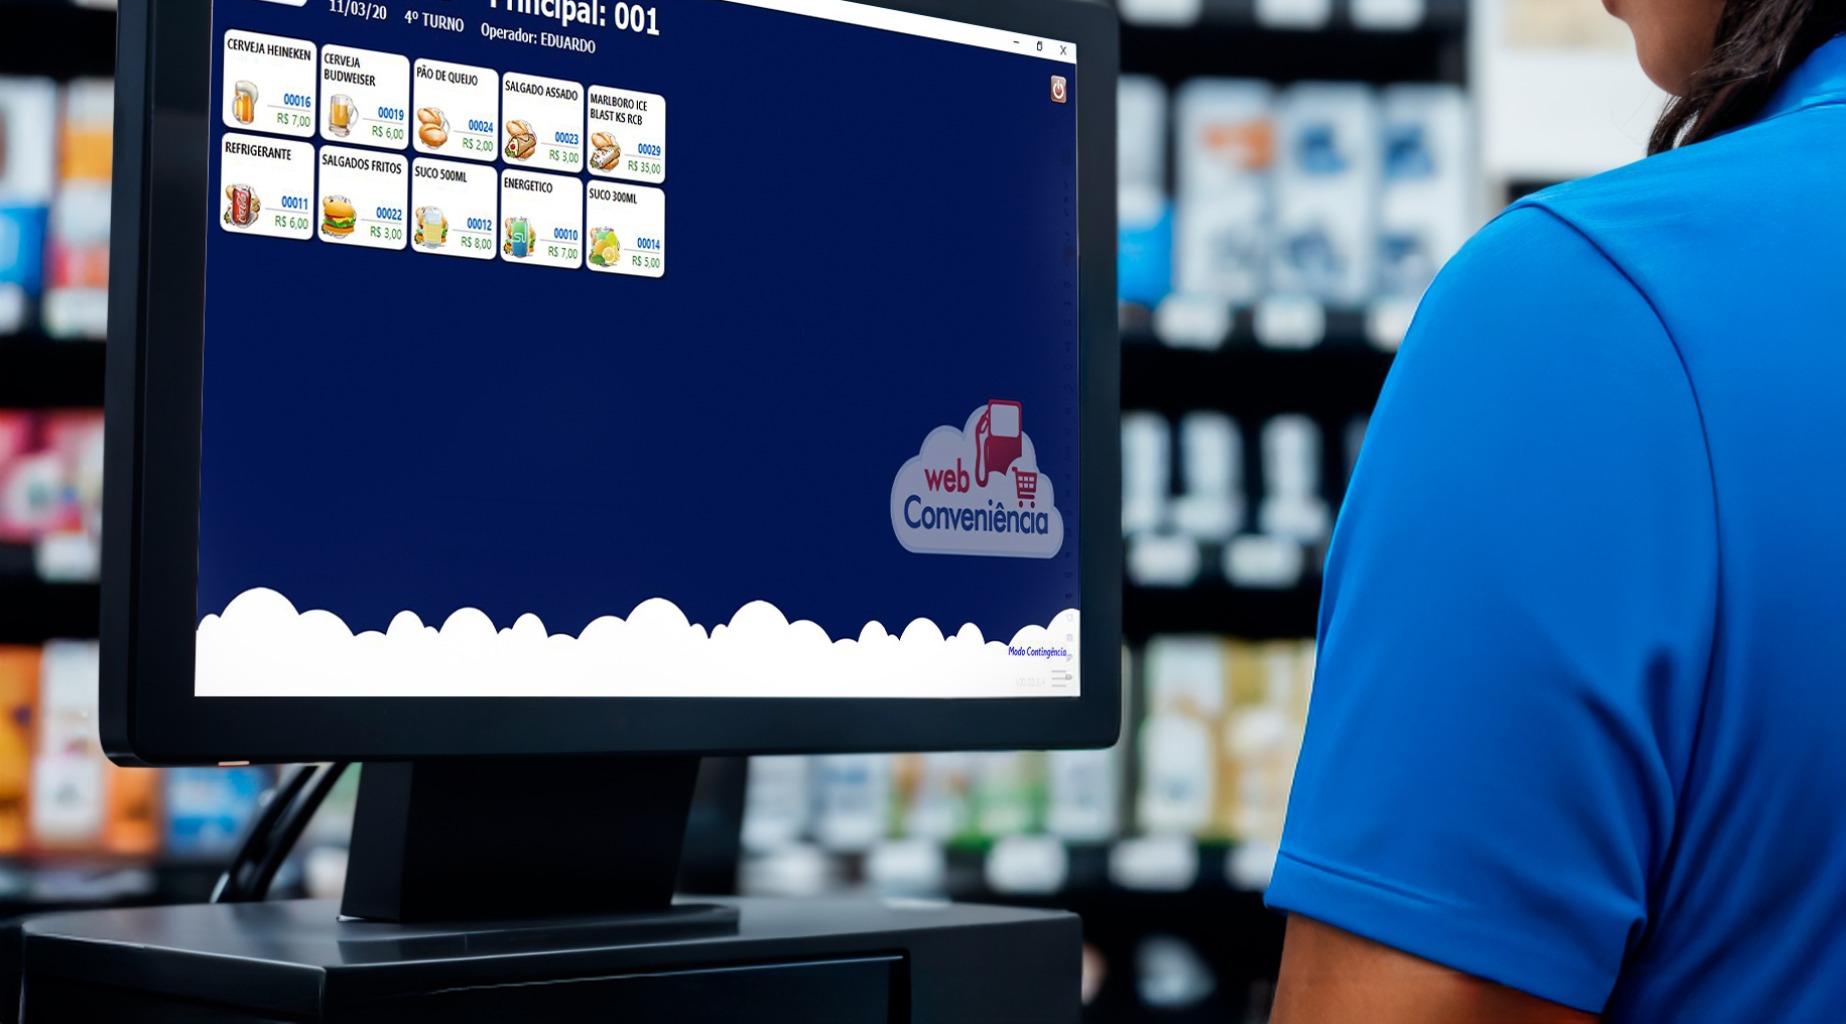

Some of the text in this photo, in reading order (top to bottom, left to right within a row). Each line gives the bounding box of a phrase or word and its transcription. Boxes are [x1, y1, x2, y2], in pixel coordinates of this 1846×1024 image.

[615, 1, 660, 37] 001
[422, 12, 464, 33] TURNO
[481, 22, 537, 45] Operador:
[541, 32, 596, 54] EDUARDO
[227, 38, 311, 61] CERVEJA HEINEKEN
[324, 53, 361, 69] CERVEJA
[324, 68, 376, 87] BUDWEISER
[417, 64, 478, 87] PÃO DE QUEIJO
[505, 80, 578, 101] SALGADO ASSADO
[284, 93, 311, 108] 00016
[590, 93, 648, 112] MARLBORO ICE
[277, 112, 311, 128] R$ 7,00
[378, 107, 404, 121] 00019
[590, 108, 643, 126] BLAST KS RCB
[372, 125, 404, 140] R$ 6,00
[468, 119, 494, 133] 00024
[462, 137, 494, 152] R$ 2,00
[555, 131, 579, 145] 00023
[225, 141, 292, 161] REFRIGERANTE
[549, 149, 579, 164] R$ 3,00
[638, 143, 661, 157] 00029
[322, 154, 402, 175] SALGADOS FRITOS
[628, 160, 661, 175] R$ 35,00
[415, 165, 467, 183] SUCO 500ML
[504, 177, 553, 194] ENERGETICO
[282, 195, 309, 210] 00011
[589, 188, 637, 205] SUCO 300ML
[376, 206, 402, 221] 00022
[275, 215, 309, 230] R$ 6,00
[467, 217, 492, 231] 00012
[370, 225, 402, 240] R$ 3,00
[554, 227, 578, 241] 00010
[461, 236, 492, 250] R$ 8,00
[637, 237, 660, 251] 00014
[548, 246, 578, 260] R$ 7,00
[632, 255, 660, 269] R$ 5,00
[924, 458, 969, 493] web
[904, 494, 1048, 535] Conveniência
[1008, 646, 1067, 659] Modo Contingência
